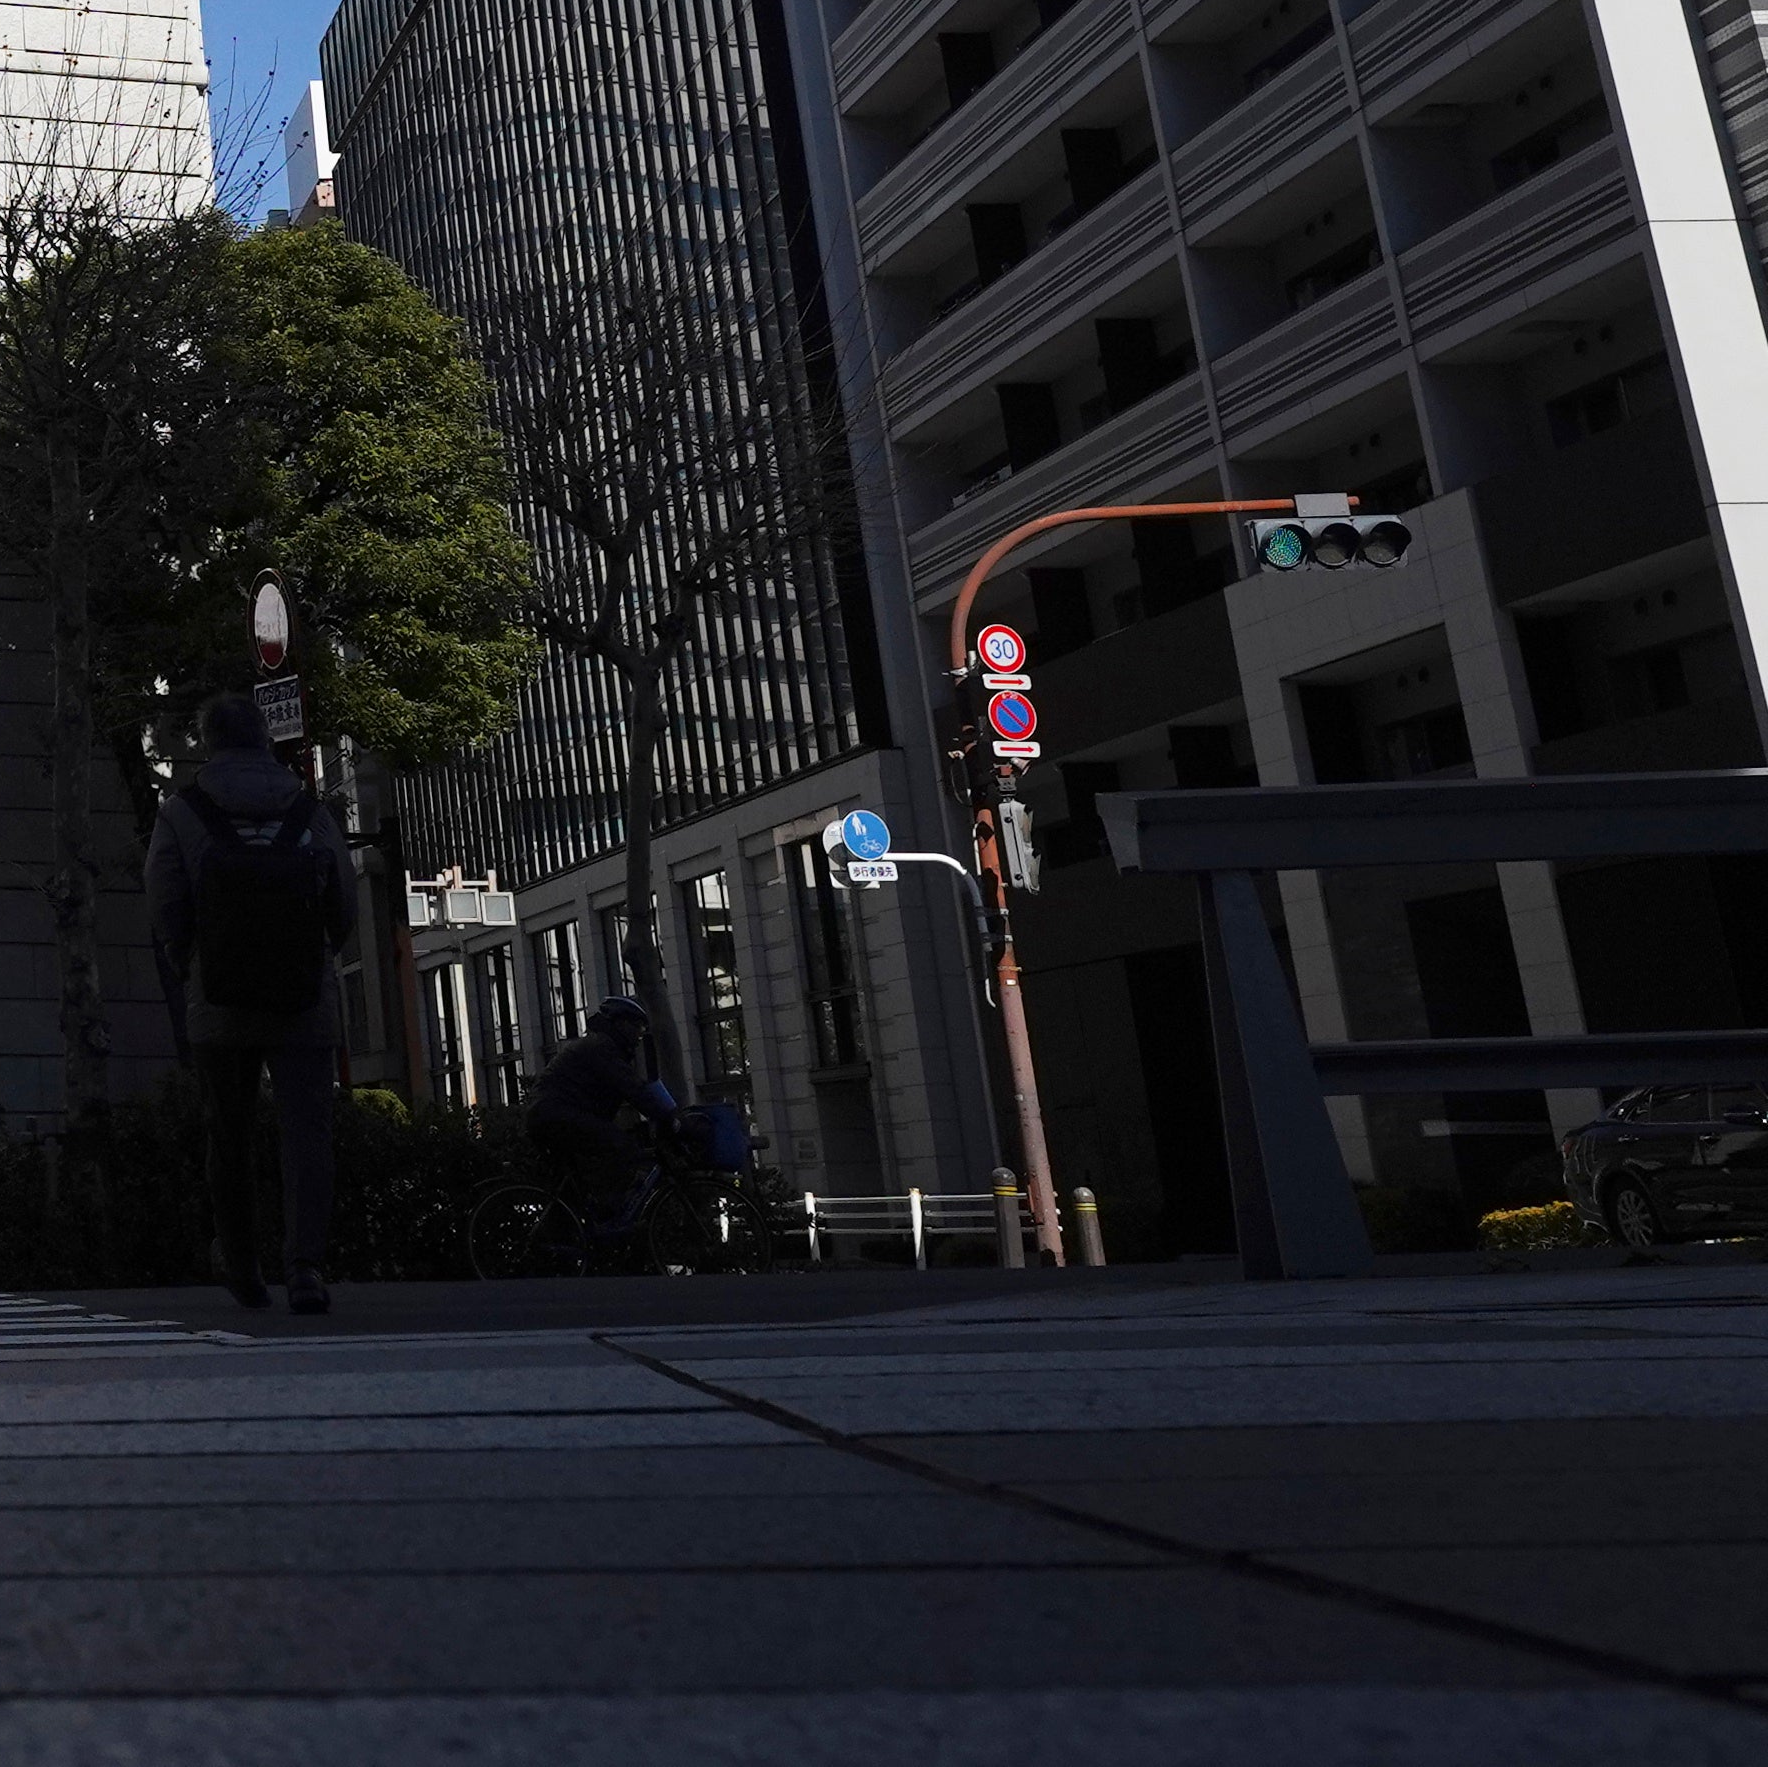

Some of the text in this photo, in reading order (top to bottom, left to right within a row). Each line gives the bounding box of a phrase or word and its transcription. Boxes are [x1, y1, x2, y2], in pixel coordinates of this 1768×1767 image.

[990, 639, 1015, 659] 30
[853, 866, 894, 878] 歩行者優先
